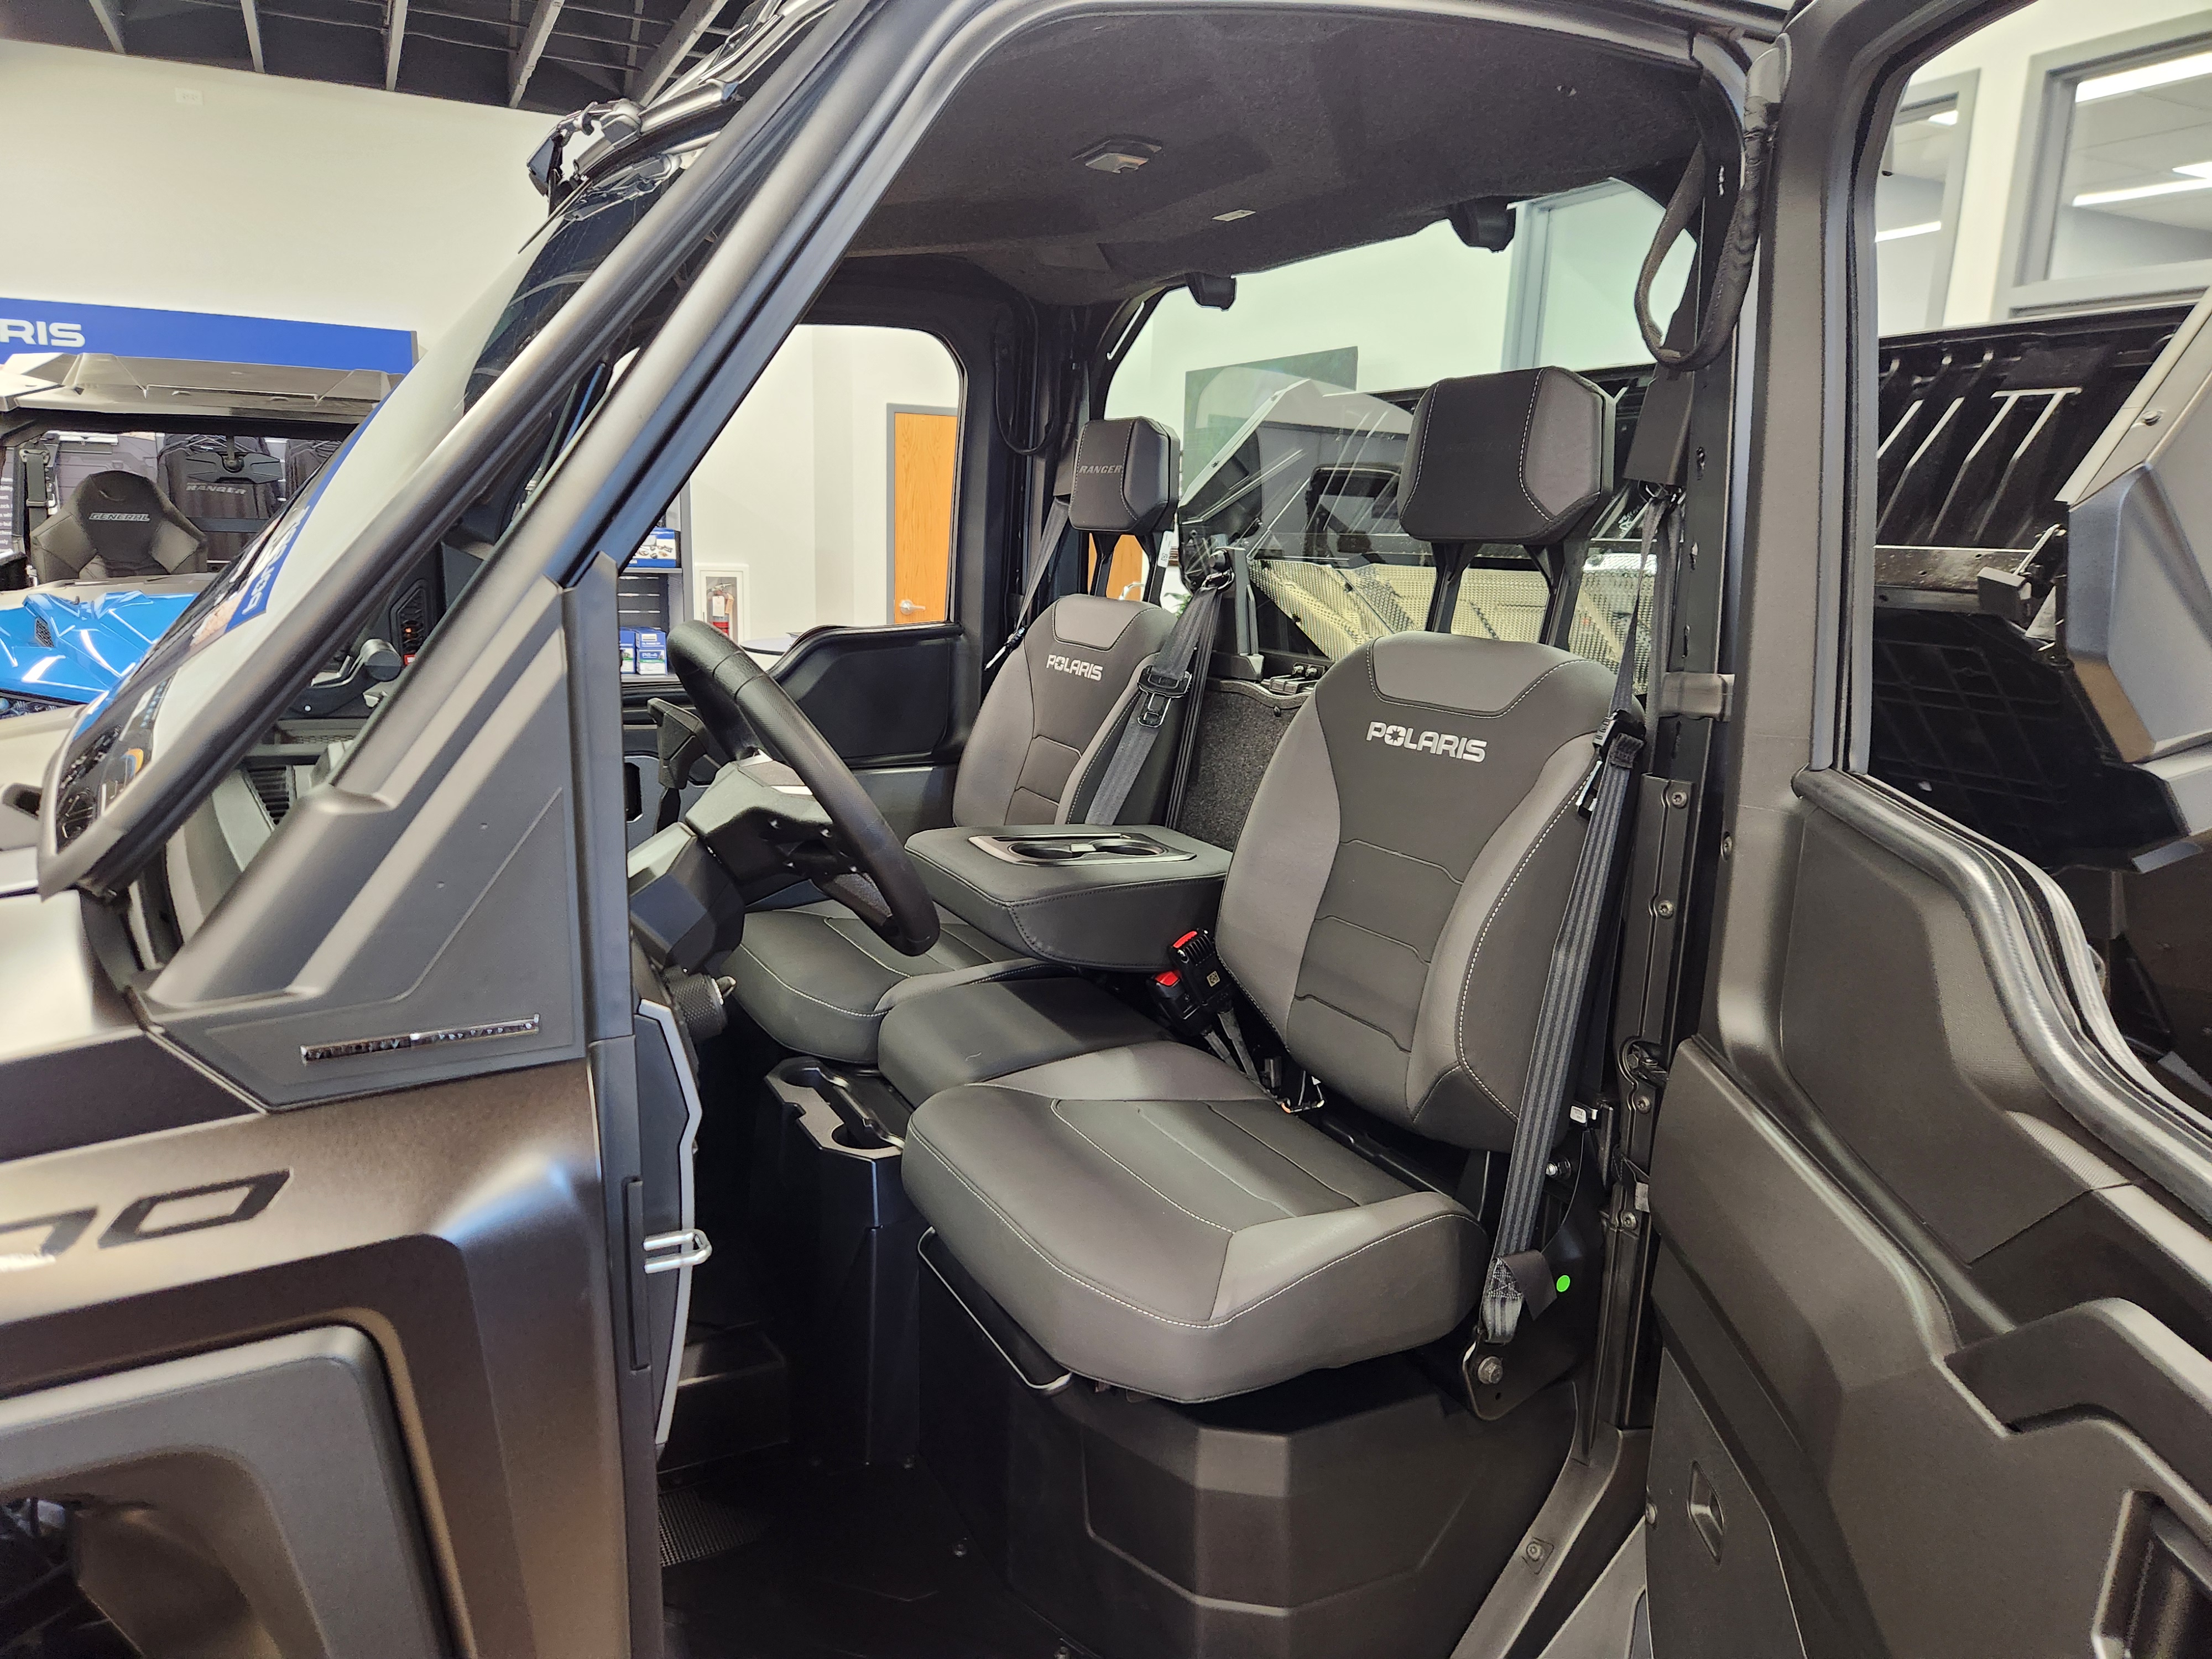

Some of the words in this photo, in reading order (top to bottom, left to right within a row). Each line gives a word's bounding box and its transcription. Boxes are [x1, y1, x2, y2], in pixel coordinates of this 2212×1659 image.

[0, 318, 85, 348] RIS
[1079, 465, 1123, 474] RANGER
[89, 513, 150, 521] GENERAL
[1046, 654, 1103, 681] POLARIS
[1366, 721, 1488, 763] POLARIS
